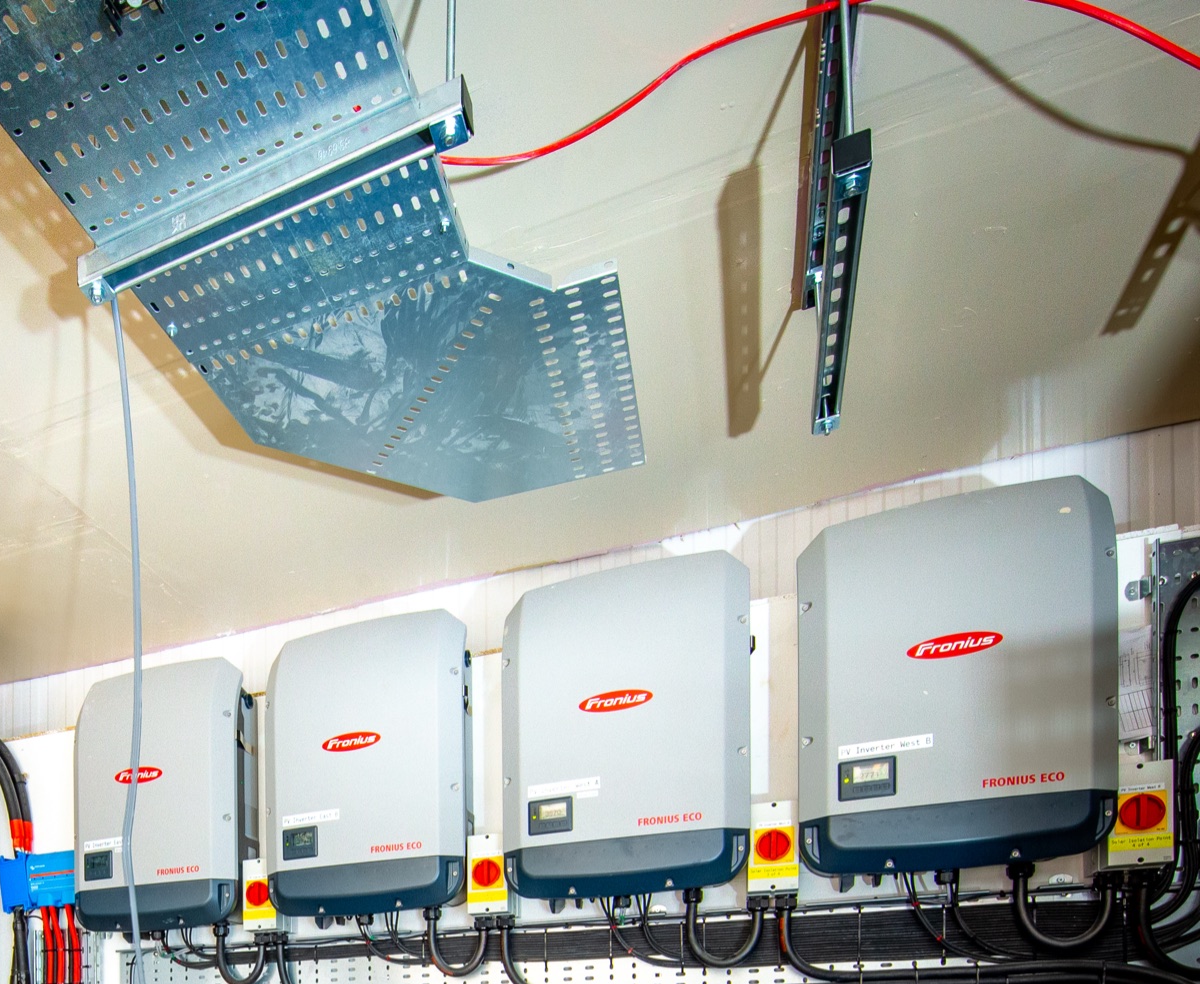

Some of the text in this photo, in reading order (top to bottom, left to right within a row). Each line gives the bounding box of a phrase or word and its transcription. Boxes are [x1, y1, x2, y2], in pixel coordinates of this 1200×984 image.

[914, 635, 996, 657] Fronius
[585, 693, 647, 710] Fronius
[326, 735, 377, 749] Fronius
[855, 742, 895, 755] Inverter
[899, 738, 920, 748] West
[925, 737, 932, 745] B
[119, 769, 159, 781] Frnius
[982, 771, 1065, 788] FRONIUS ECO
[637, 812, 702, 827] FRONIUS ECO
[370, 841, 422, 853] FRONIUS ECO
[156, 865, 200, 876] FRONIUS ECO
